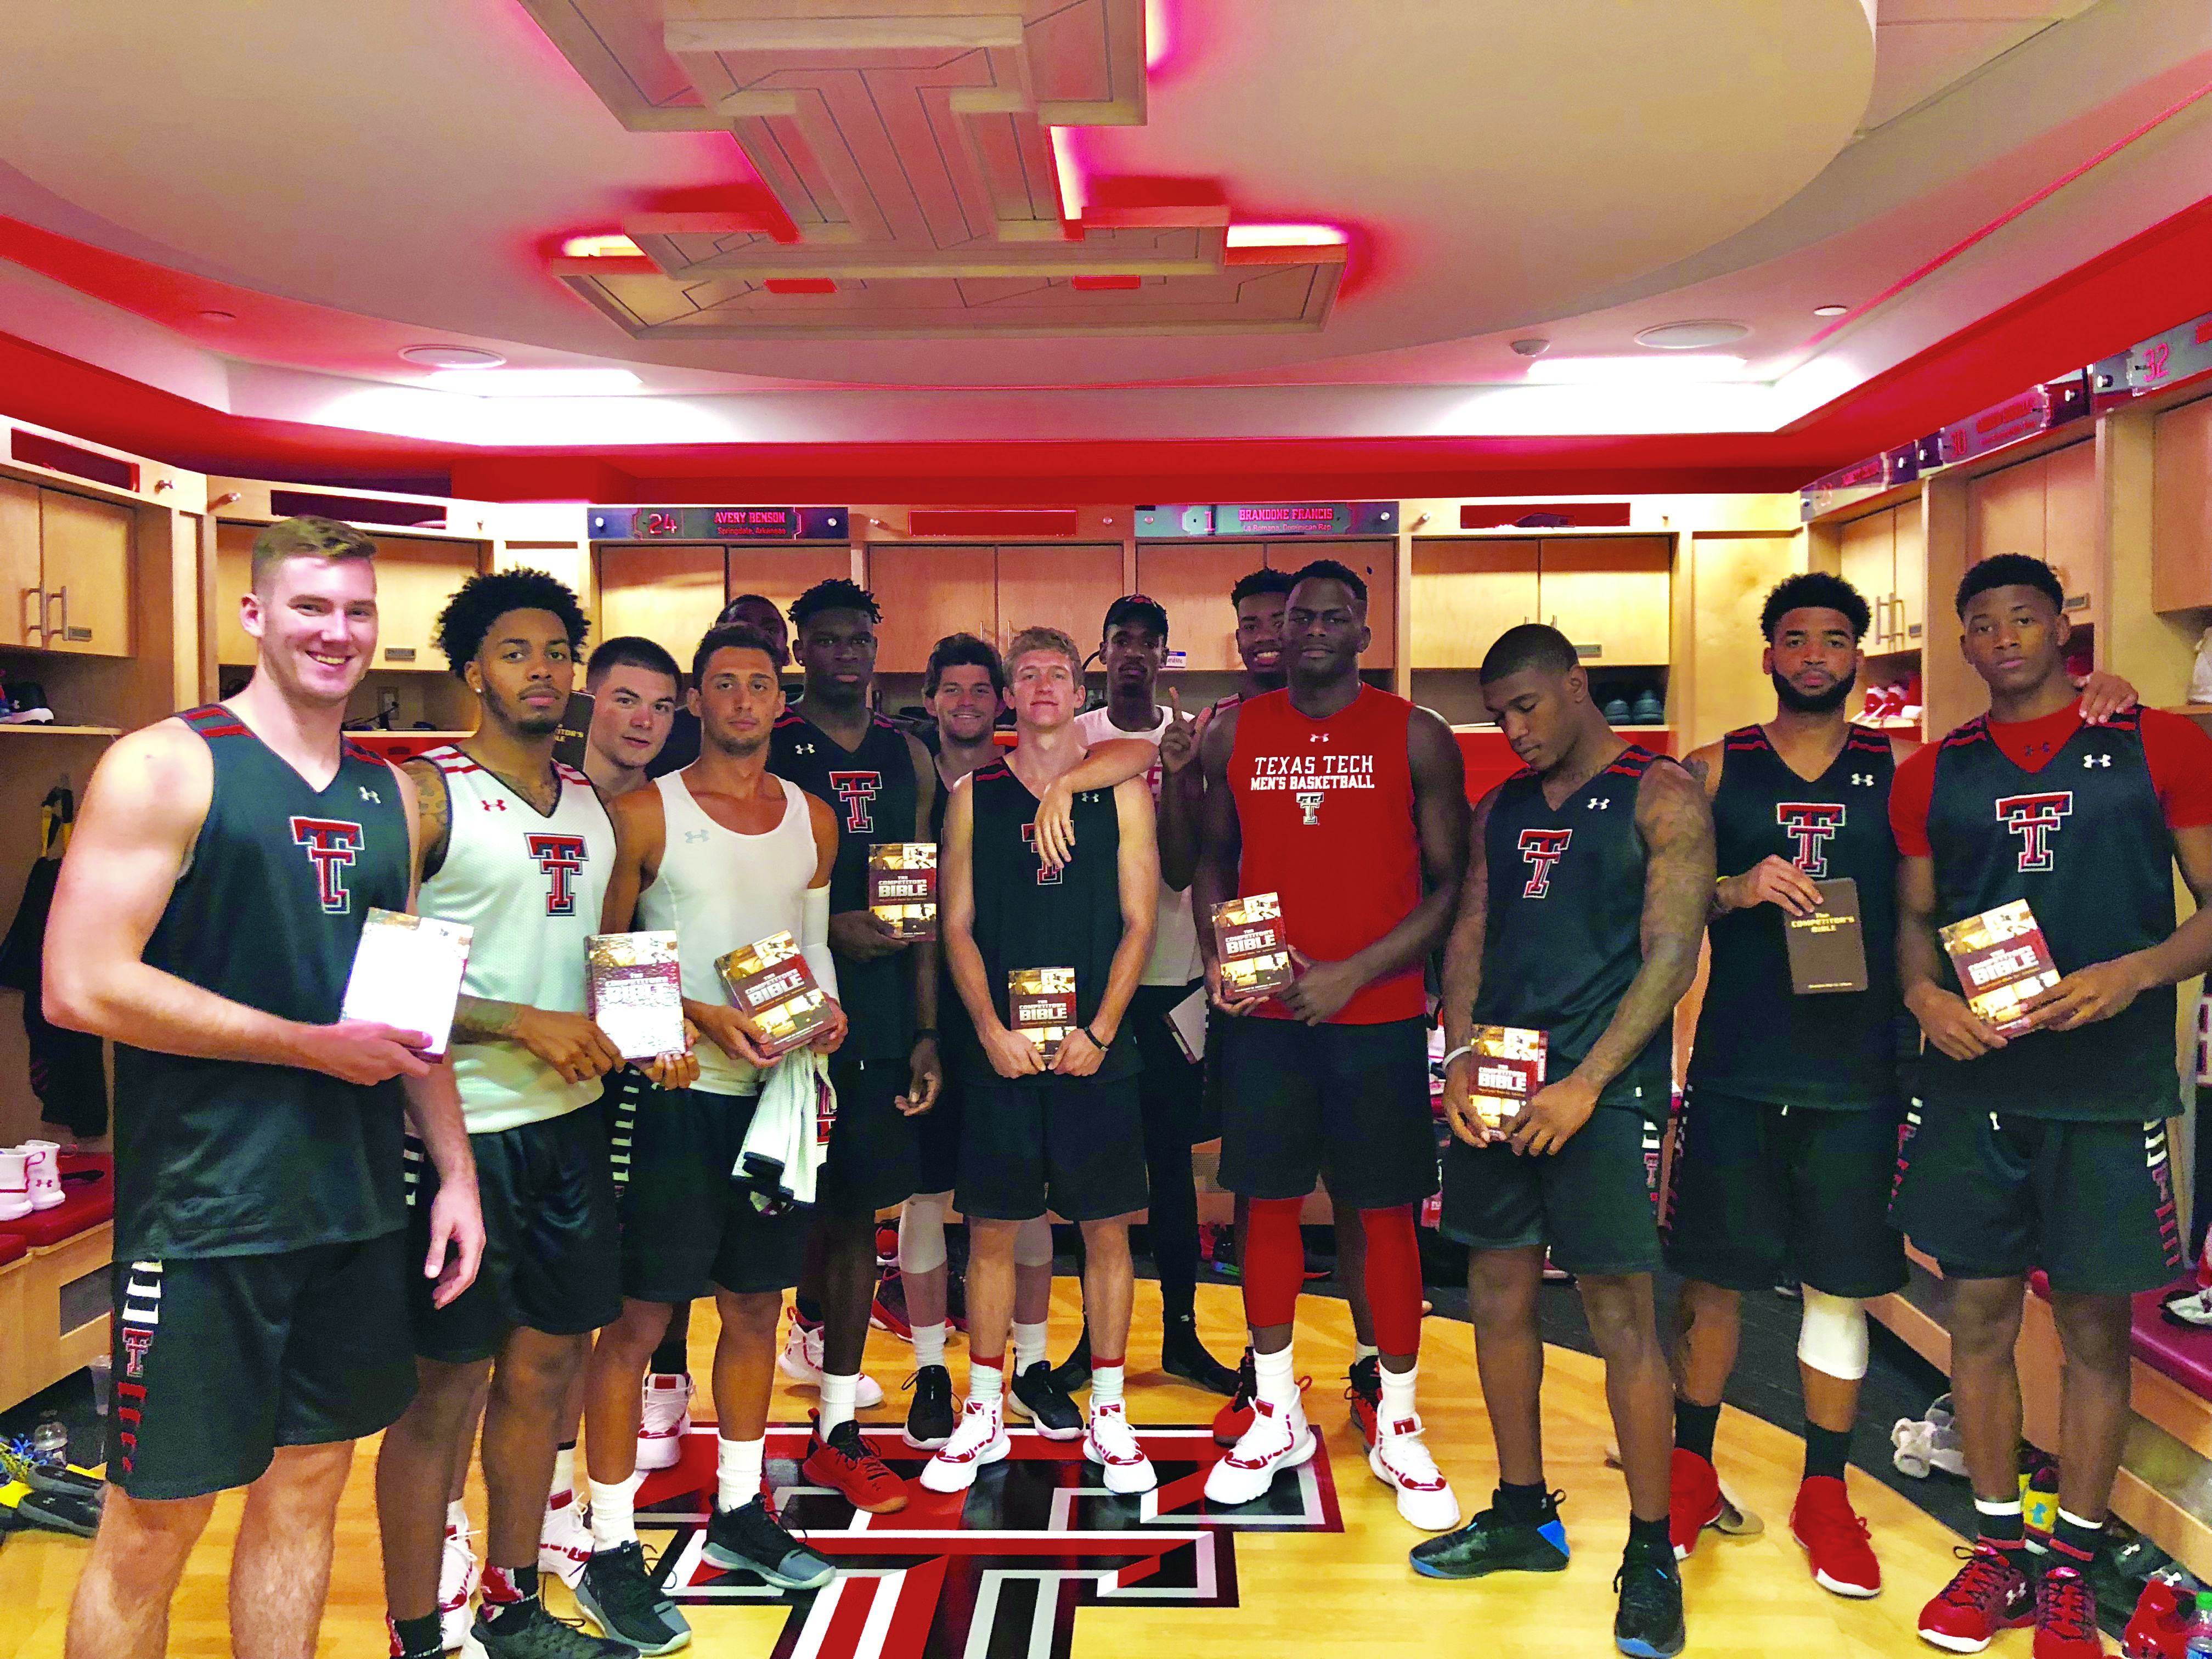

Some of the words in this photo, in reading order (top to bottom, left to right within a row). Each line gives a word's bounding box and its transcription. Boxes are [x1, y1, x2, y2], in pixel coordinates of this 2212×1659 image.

[2143, 343, 2169, 382] 32
[649, 514, 677, 534] 24
[714, 512, 746, 523] AVERY
[749, 512, 785, 523] BENSON
[1204, 511, 1216, 532] 1
[1239, 509, 1290, 521] BRANDONE
[1292, 508, 1333, 520] FRANCIS
[1255, 756, 1316, 775] TEXAS
[1323, 755, 1373, 774] TECH
[1250, 776, 1286, 791] MEN'S
[1289, 775, 1375, 790] BASKETBALL
[879, 884, 927, 897] BIBLE
[1226, 934, 1276, 954] BIBLE
[1971, 951, 2039, 985] BIBLE
[747, 973, 805, 1007] BIBLE
[1020, 1008, 1067, 1021] BIBLE
[1479, 1073, 1527, 1092] BIBLE
